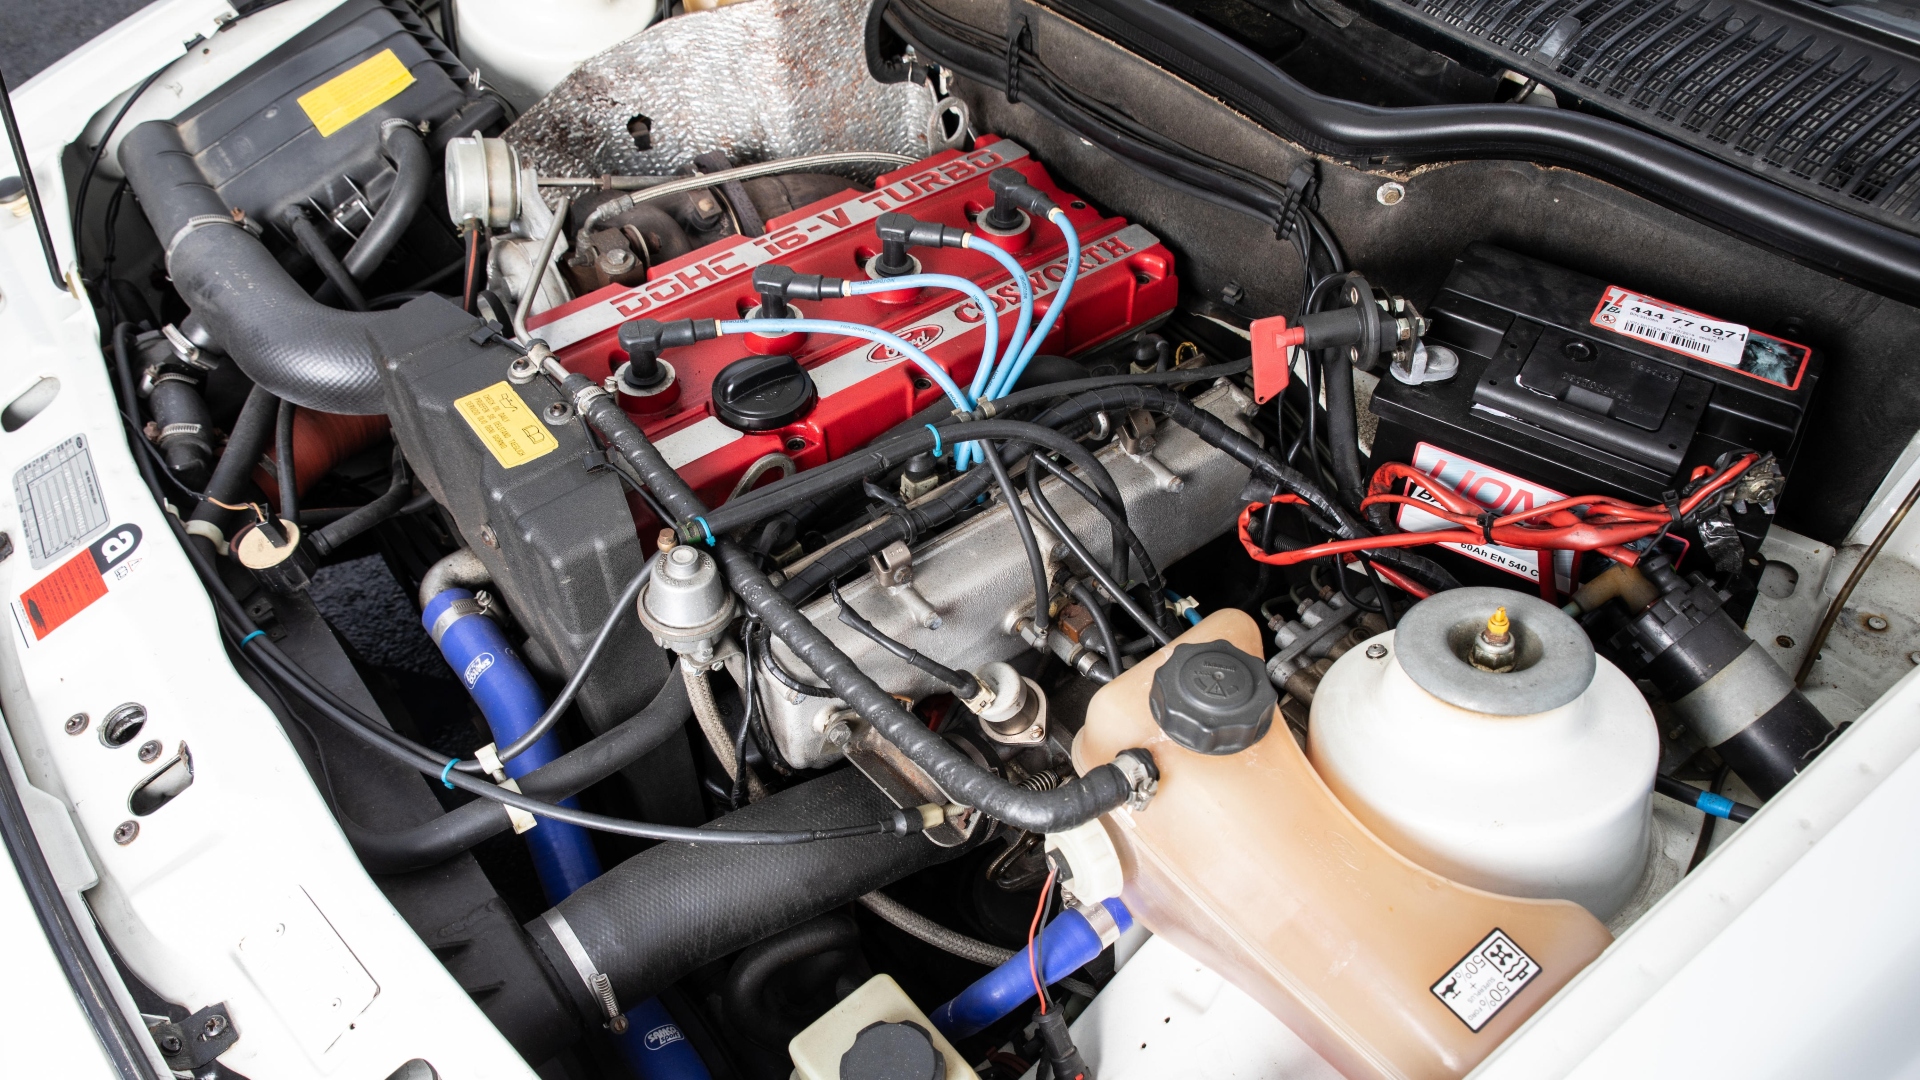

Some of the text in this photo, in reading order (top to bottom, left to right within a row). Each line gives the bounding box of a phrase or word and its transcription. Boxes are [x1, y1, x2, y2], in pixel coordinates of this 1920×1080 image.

[611, 252, 748, 318] DOHC
[868, 149, 1003, 212] TURBO
[954, 235, 1135, 324] COSWORTH
[1631, 306, 1665, 321] 444
[1671, 316, 1695, 328] 77
[1700, 325, 1747, 342] 0971
[1460, 542, 1488, 559] 60Ah
[1489, 552, 1507, 565] EN
[1507, 560, 1528, 573] 540
[1454, 954, 1487, 983] 50%
[1467, 976, 1496, 1004] SUPERPLUS
[1467, 981, 1511, 1021] 50% FORD
[647, 1026, 677, 1043] SAMCO
